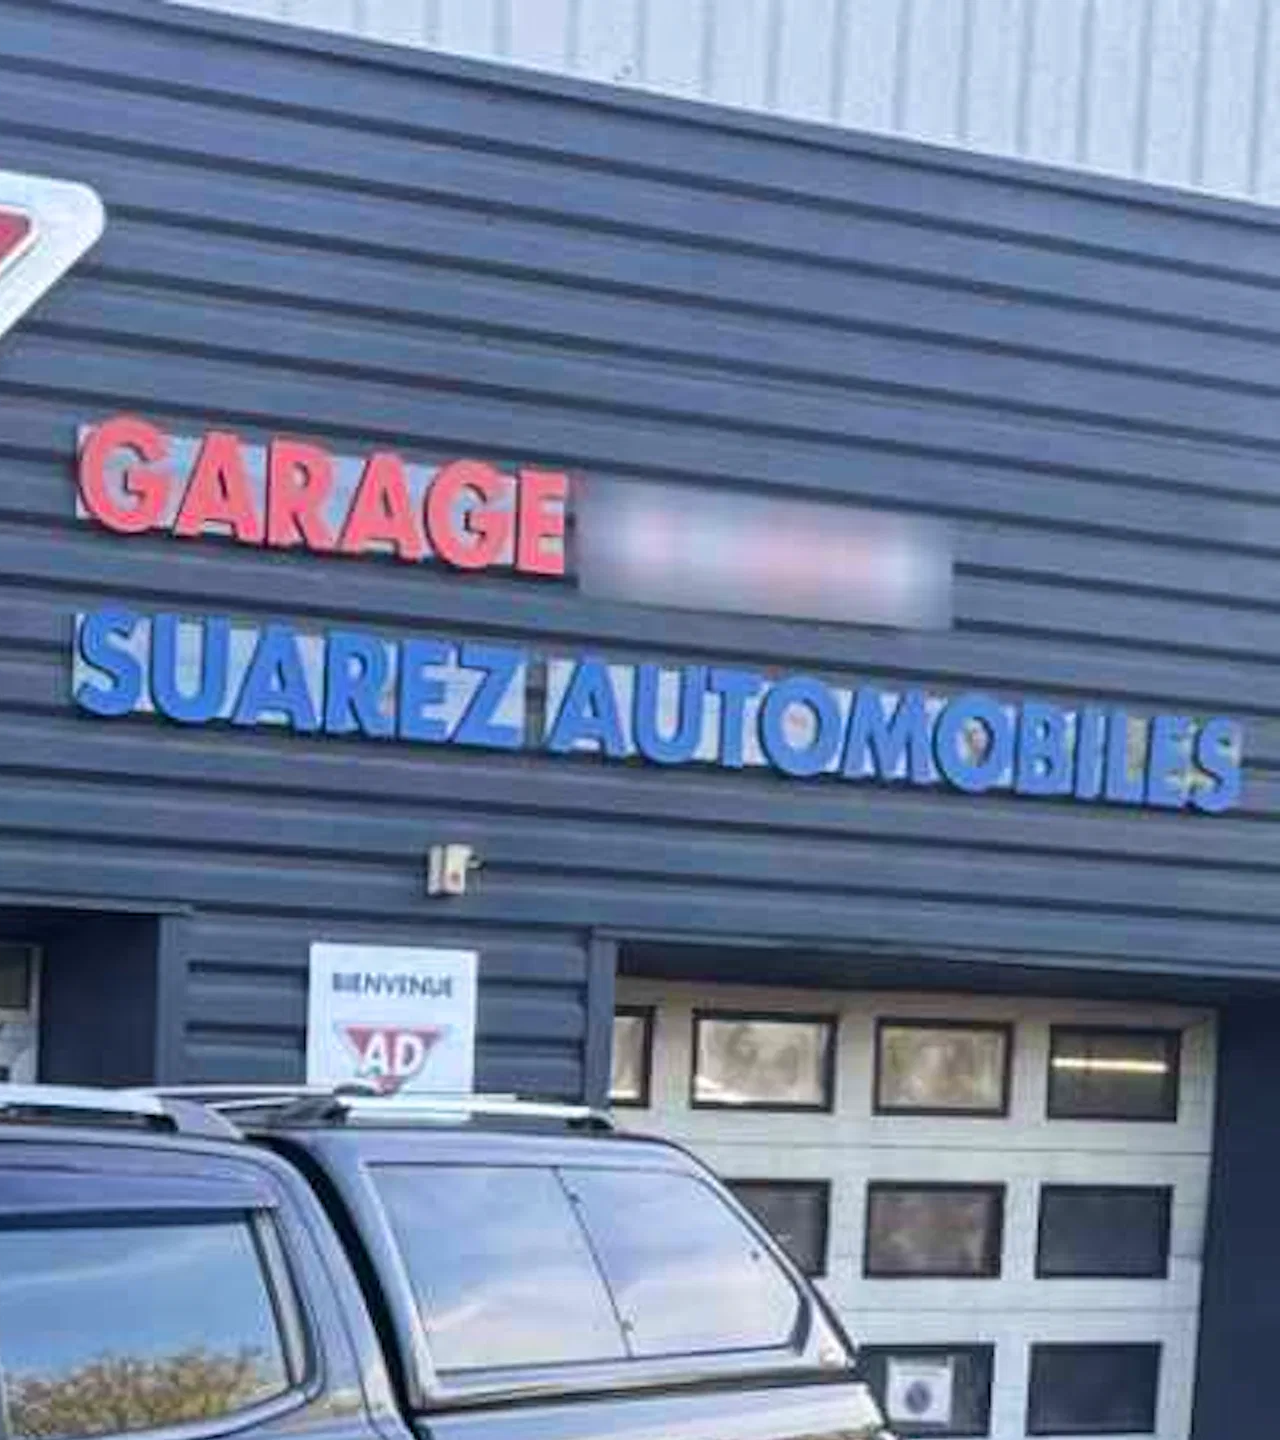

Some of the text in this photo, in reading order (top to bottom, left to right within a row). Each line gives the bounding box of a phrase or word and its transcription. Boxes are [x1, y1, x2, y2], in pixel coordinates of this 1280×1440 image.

[78, 416, 568, 575] GARAGE
[77, 608, 1240, 812] SUAREZ AUTOMOBILES
[332, 971, 452, 997] BIENVENUE
[361, 1032, 424, 1076] AD
